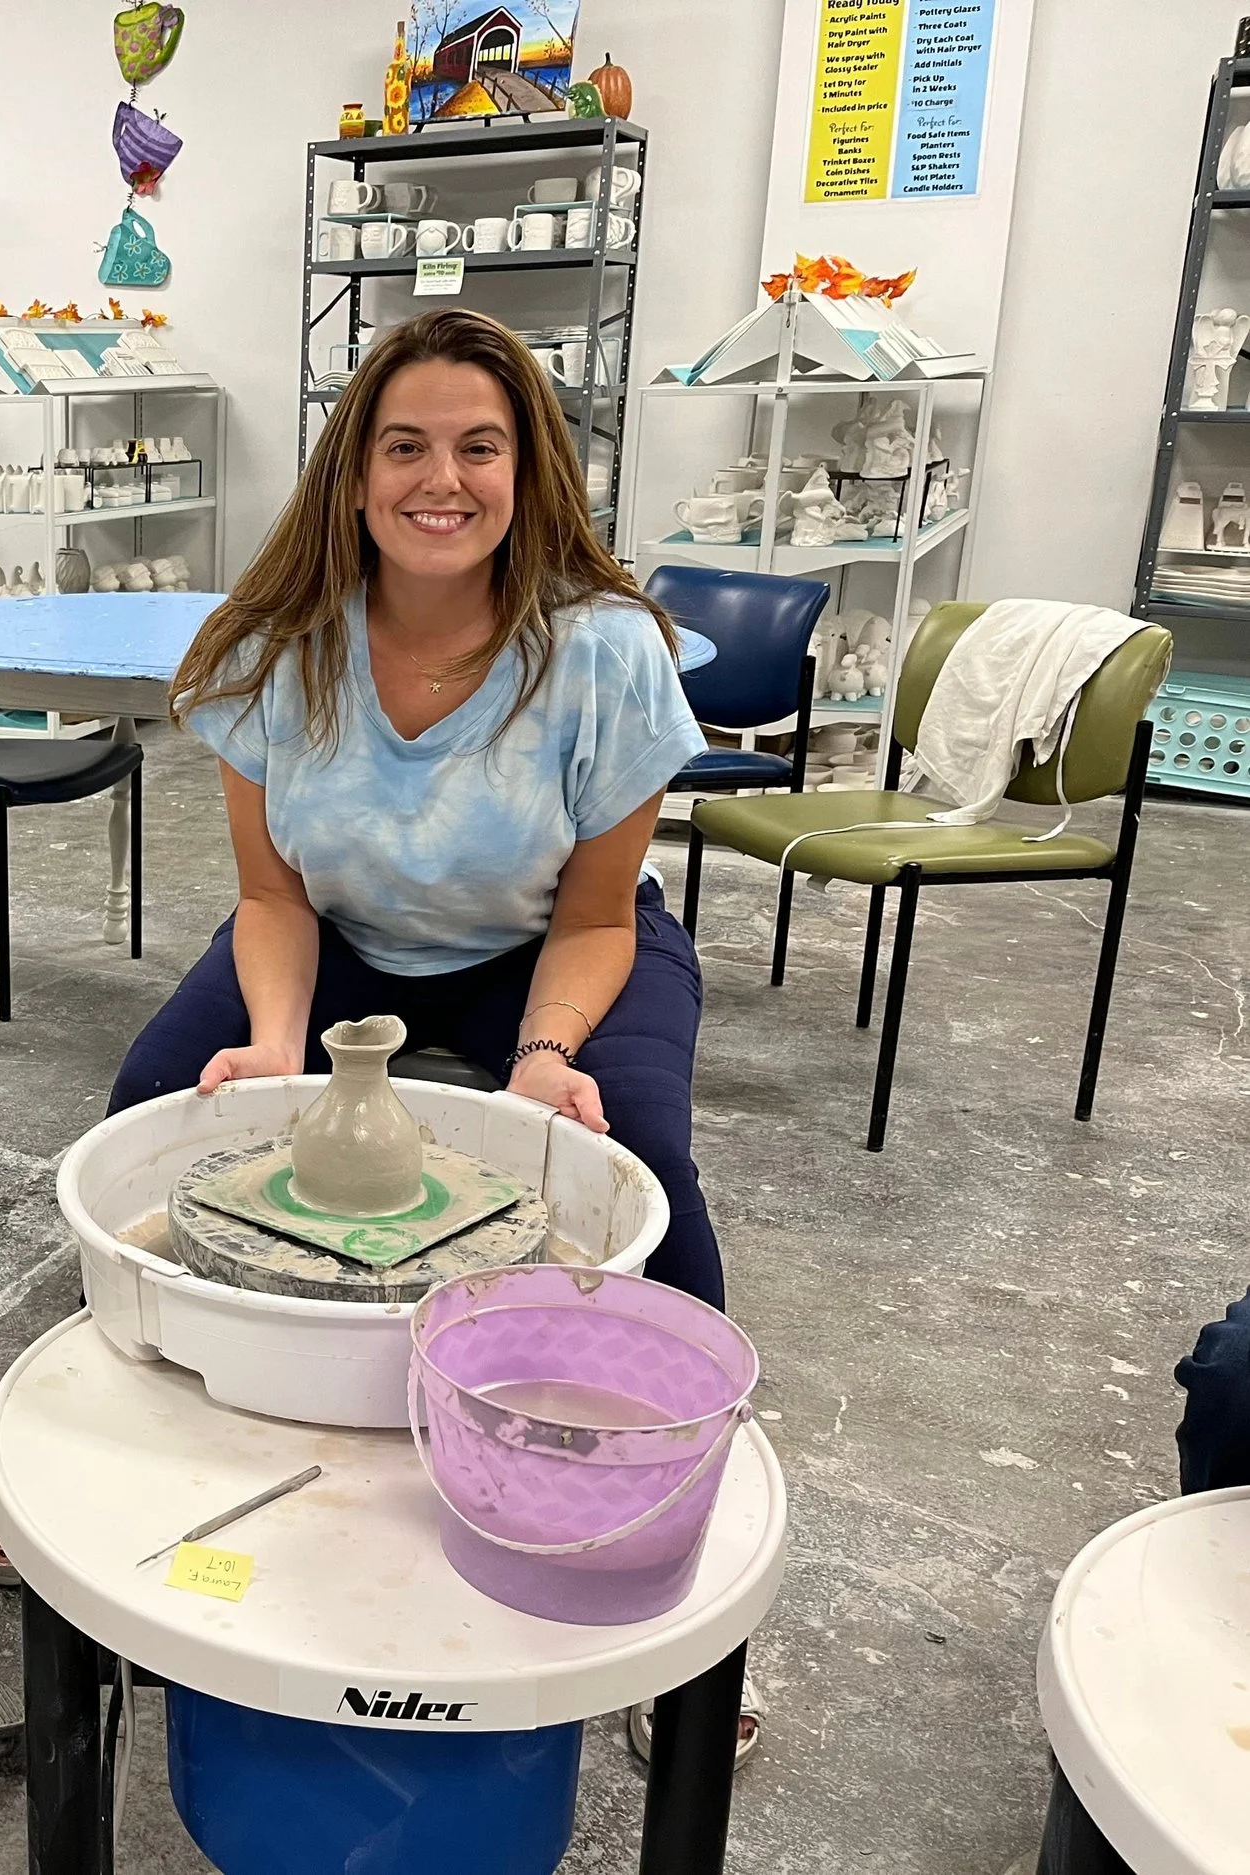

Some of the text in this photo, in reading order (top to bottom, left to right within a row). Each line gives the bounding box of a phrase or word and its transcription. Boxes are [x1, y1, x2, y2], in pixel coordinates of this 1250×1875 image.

[828, 0, 862, 9] Ready
[920, 8, 952, 16] Pottery
[830, 13, 886, 24] Acrylic Paints
[845, 28, 867, 36] Paint
[937, 45, 956, 53] Hair
[933, 59, 962, 67] Initials
[822, 102, 887, 113] Included in price
[917, 116, 944, 129] Perfect
[829, 122, 857, 135] Perfect
[907, 132, 926, 140] Food
[833, 137, 869, 146] Figurines
[816, 179, 857, 187] Decorative
[824, 189, 867, 197] Ornaments
[202, 1574, 241, 1591] Laura
[337, 1687, 478, 1721] Nidec
